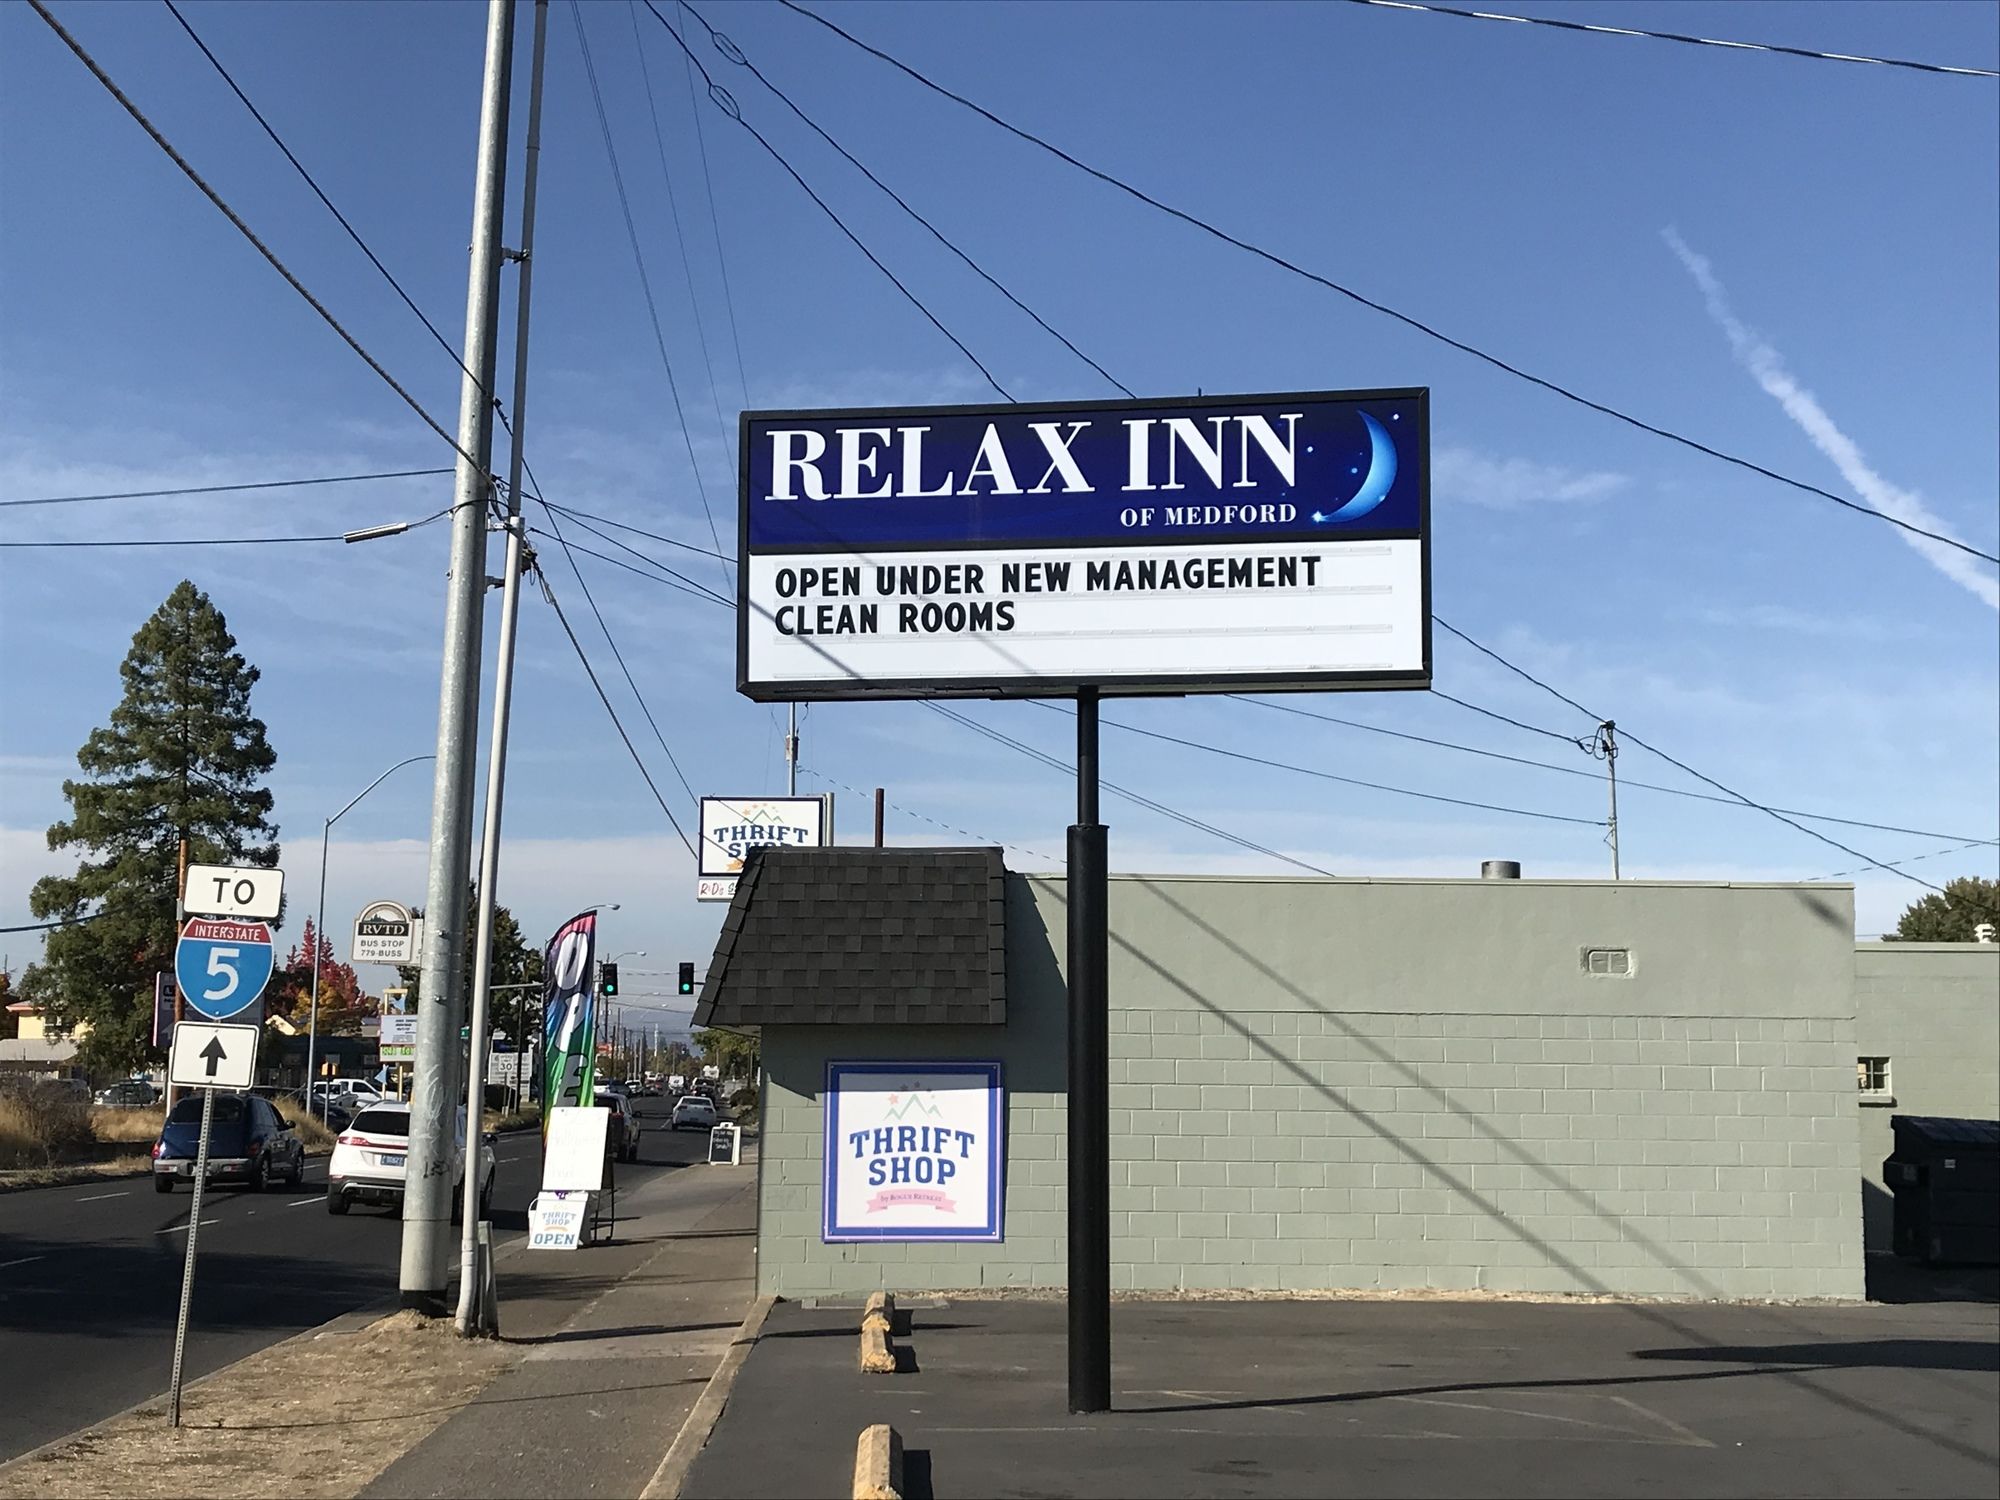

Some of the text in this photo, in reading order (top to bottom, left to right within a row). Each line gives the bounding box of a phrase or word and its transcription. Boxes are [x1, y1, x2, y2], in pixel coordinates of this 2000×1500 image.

[765, 413, 1304, 501] RELAX INN
[1120, 504, 1297, 527] OF MEDFORD
[775, 556, 1321, 598] OPEN UNDER NEW MANAGEMENT
[775, 600, 1015, 635] CLEAN ROOMS
[713, 825, 809, 843] THRIFT
[212, 877, 255, 905] TO
[194, 924, 261, 941] INTERSTATE
[362, 924, 405, 935] RVTD
[361, 949, 402, 957] 779-BUSS
[381, 940, 405, 948] STOP
[203, 947, 240, 1000] 5
[499, 1063, 513, 1071] 30
[849, 1126, 975, 1158] THRIFT
[868, 1156, 956, 1186] SHOP
[541, 1211, 577, 1221] THRIFT
[545, 1218, 571, 1227] SHOP
[534, 1232, 576, 1246] OPEN
